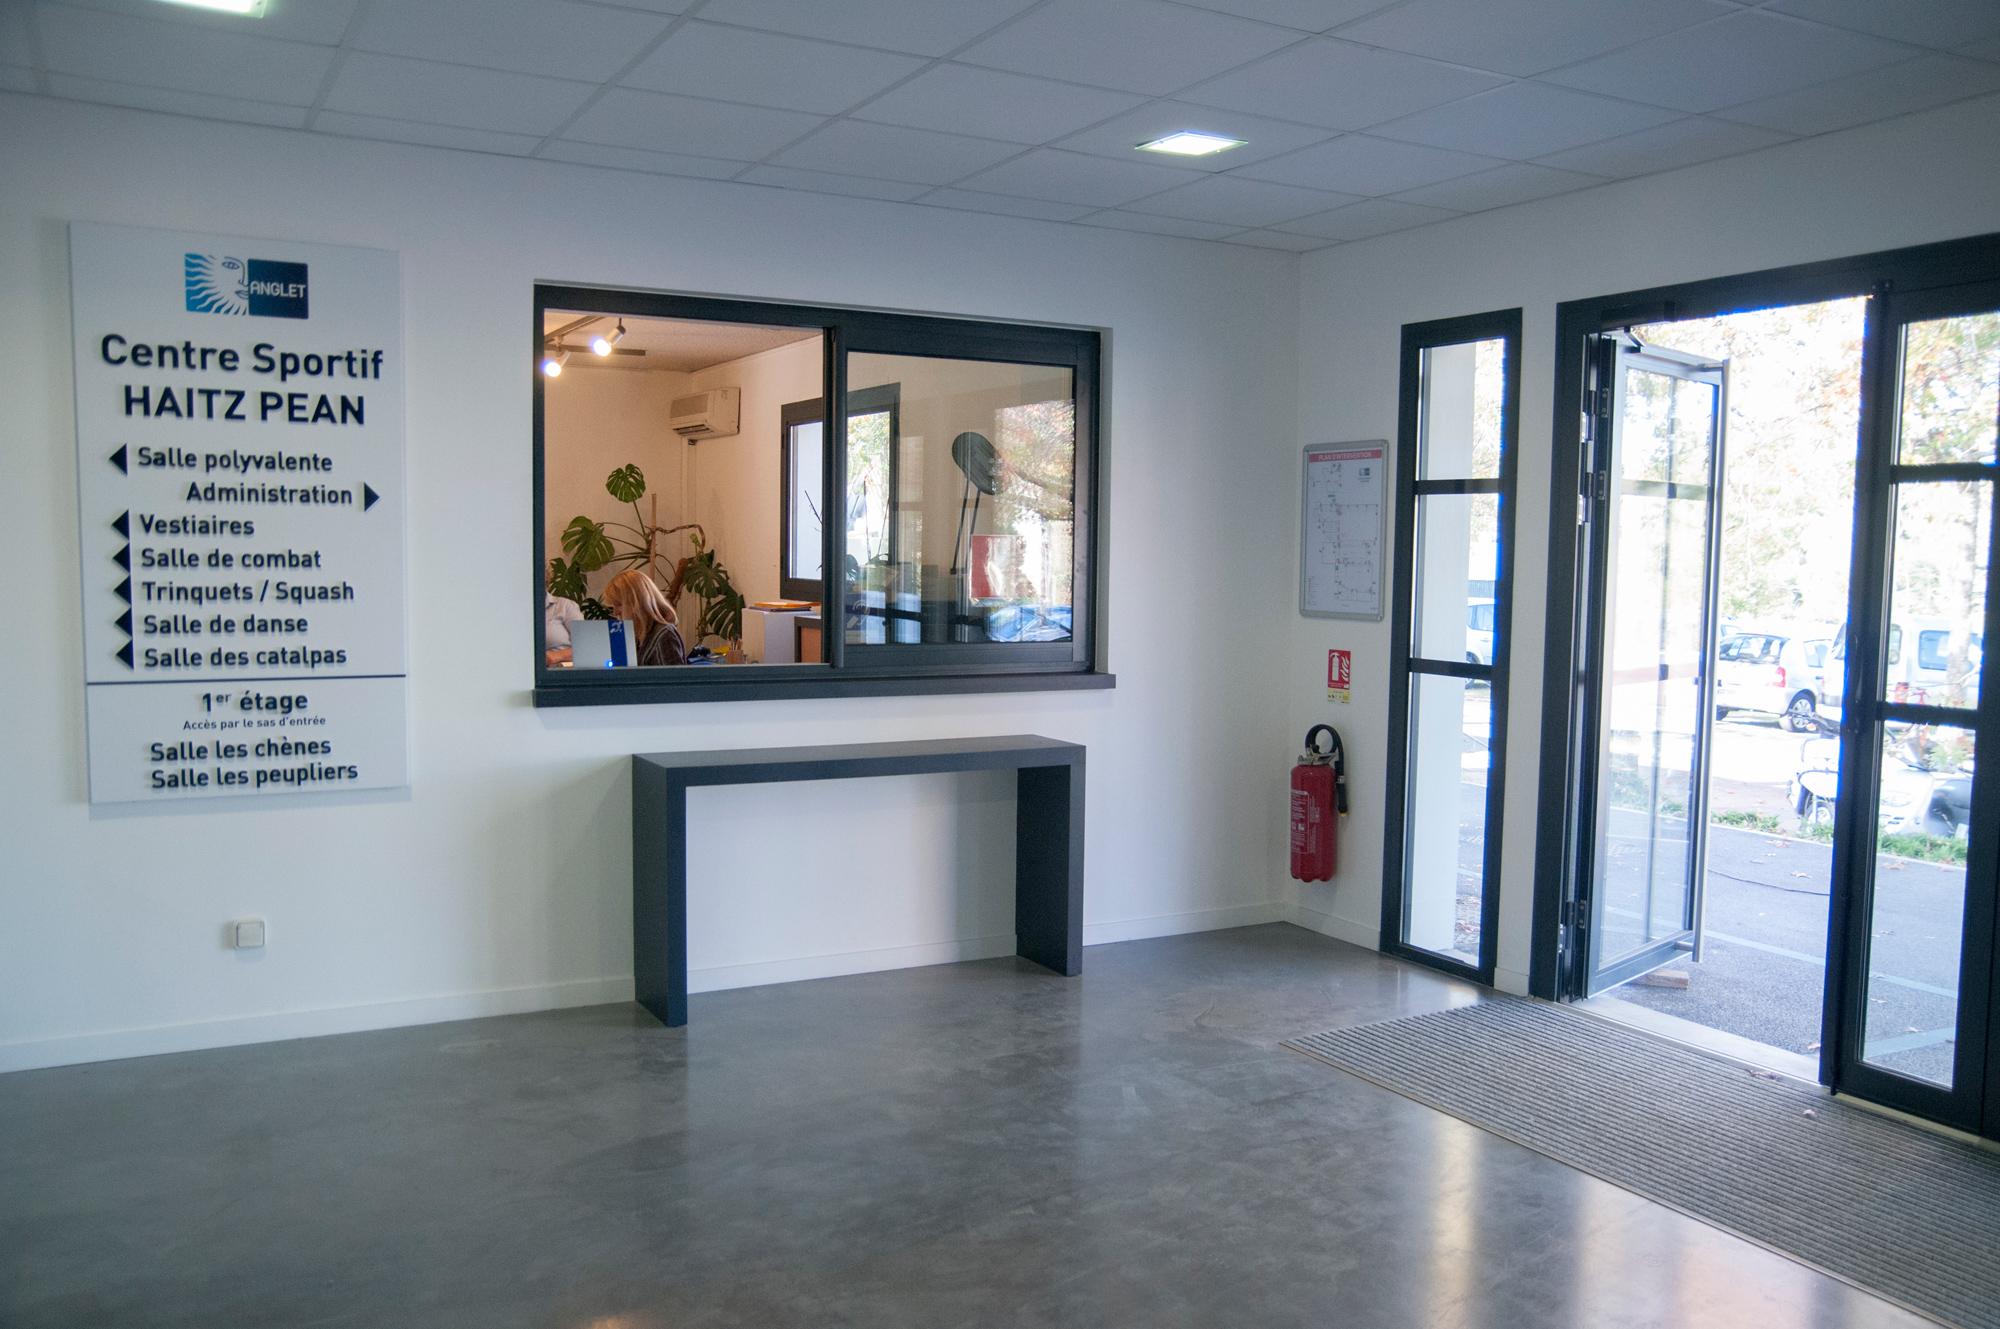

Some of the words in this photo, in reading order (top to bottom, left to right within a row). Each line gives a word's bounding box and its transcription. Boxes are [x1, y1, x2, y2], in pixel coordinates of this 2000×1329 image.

[250, 280, 306, 298] ANGLET
[101, 334, 240, 371] Centre
[252, 343, 384, 381] Sportif
[124, 385, 247, 420] HAITZ
[260, 391, 365, 425] PEAN
[138, 447, 197, 467] Salle
[205, 450, 333, 473] polyvalente
[186, 482, 353, 504] Administration
[140, 514, 255, 535] Vestiaires
[141, 548, 200, 567] Salle
[207, 549, 234, 567] de
[241, 550, 321, 567] combat
[142, 582, 254, 605] Trinquets
[259, 579, 270, 602] /
[275, 582, 354, 605] Squash
[143, 615, 202, 634] Salle
[209, 615, 236, 633] de
[243, 614, 309, 633] danse
[144, 648, 203, 667] Salle
[210, 649, 250, 667] des
[256, 646, 348, 668] catalpas
[202, 693, 231, 712] 1er
[240, 690, 308, 714] étage
[183, 719, 217, 730] Accès
[221, 719, 240, 731] par
[243, 718, 254, 728] le
[257, 717, 276, 727] sas
[150, 742, 209, 762] Salle
[215, 741, 249, 759] les
[254, 736, 332, 757] chènes
[151, 769, 210, 789] Salle
[216, 768, 249, 786] les
[256, 763, 359, 788] peupliers
